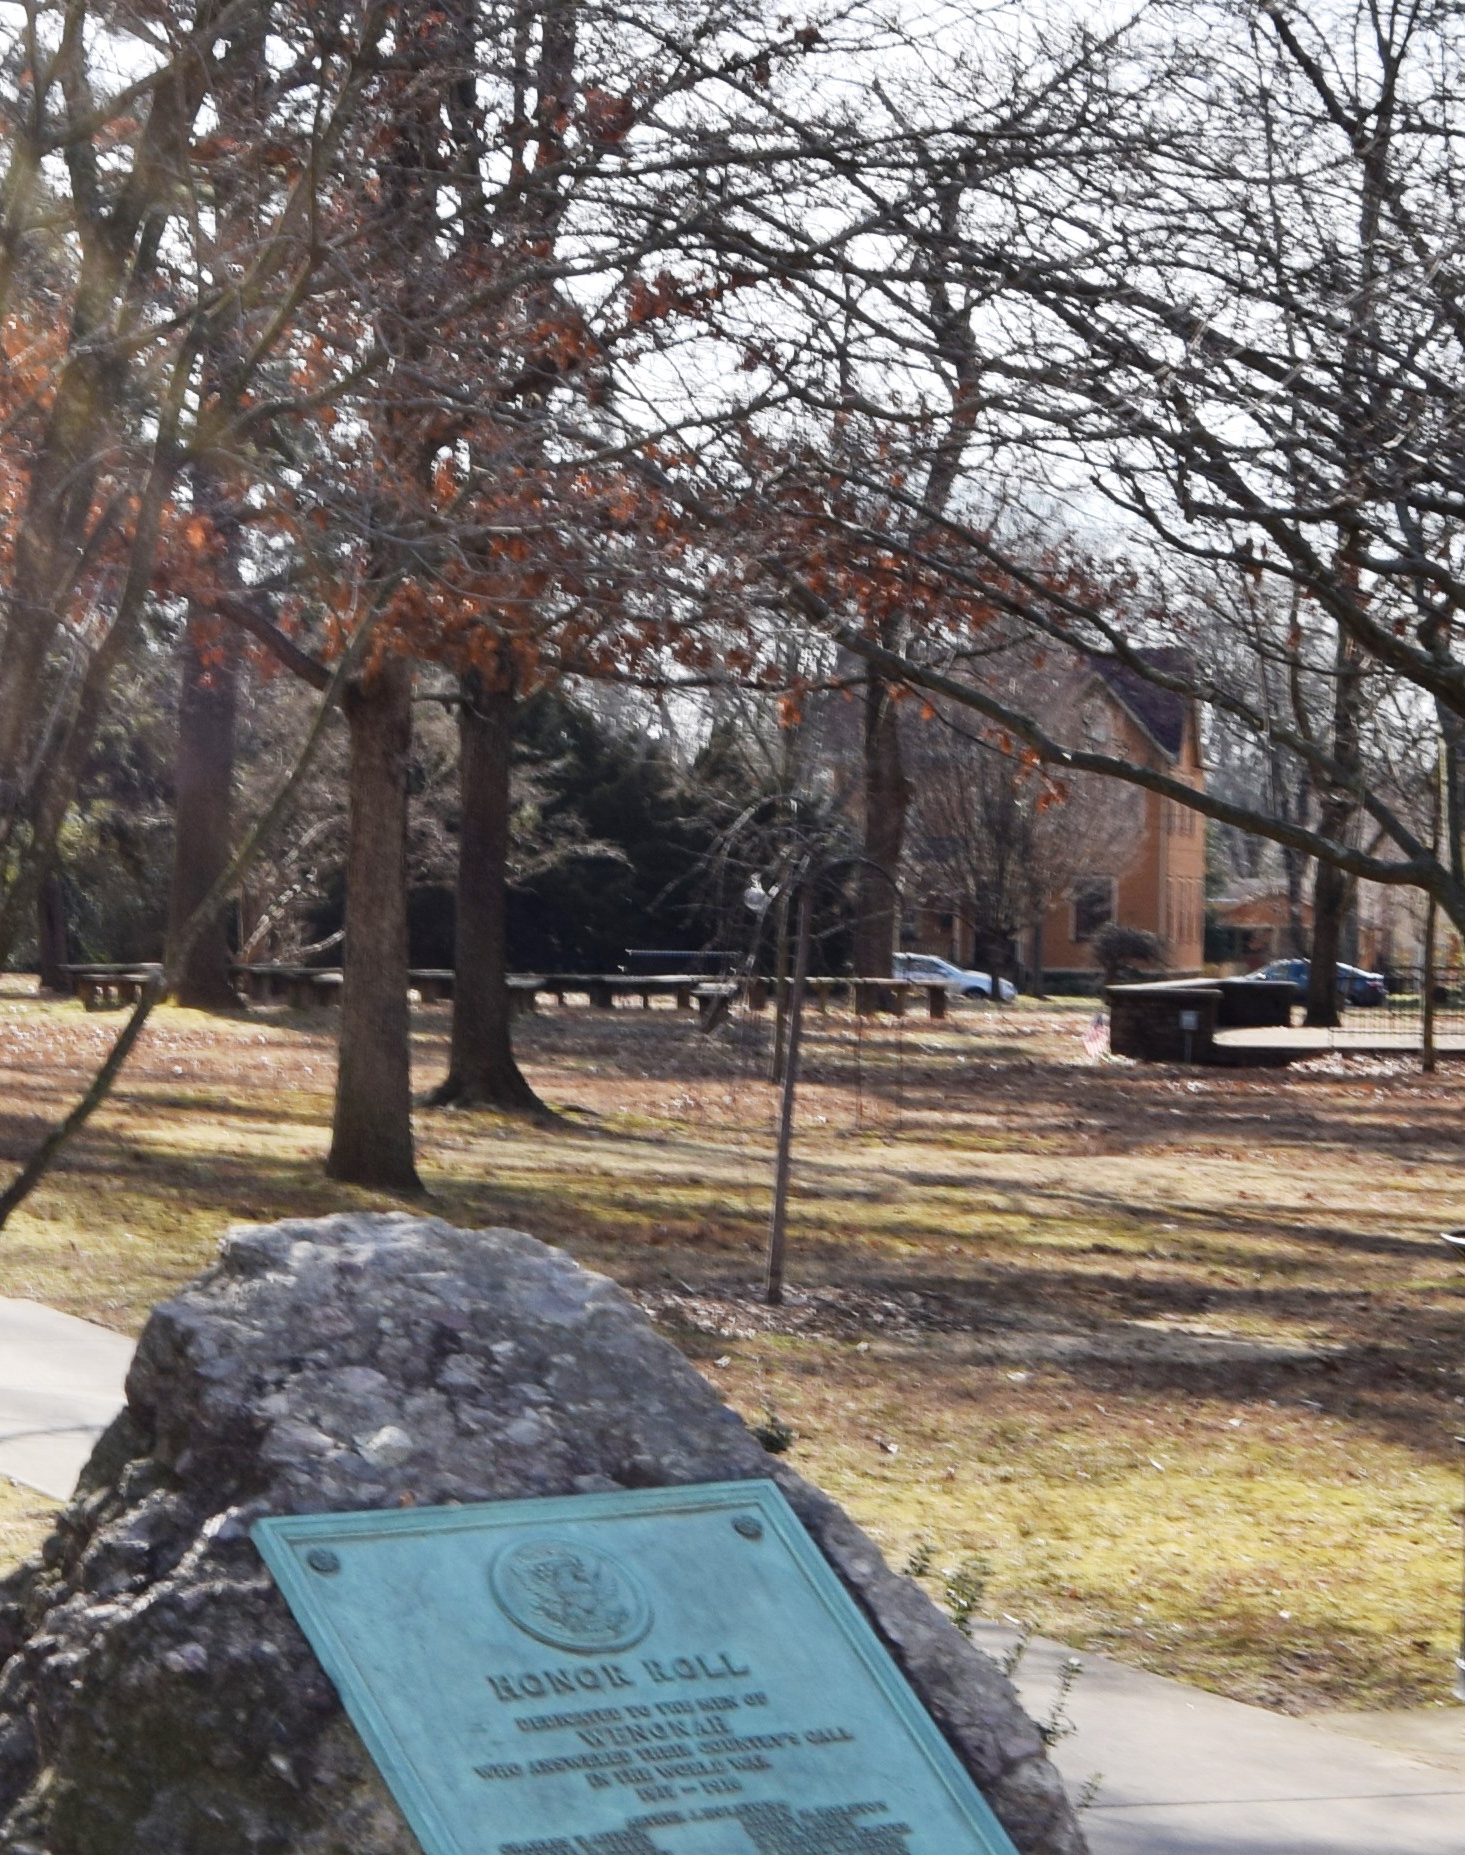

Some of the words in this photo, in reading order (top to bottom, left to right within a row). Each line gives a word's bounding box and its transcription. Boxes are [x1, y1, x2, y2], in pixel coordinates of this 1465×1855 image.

[486, 1662, 634, 1702] HONOR
[641, 1652, 750, 1683] ROLL
[624, 1705, 651, 1718] TO
[654, 1700, 694, 1716] THE
[743, 1692, 768, 1706] OF
[576, 1715, 732, 1748] WENONAH
[472, 1762, 523, 1780] WHO
[803, 1727, 855, 1744] CALL
[654, 1760, 727, 1779] WORLD
